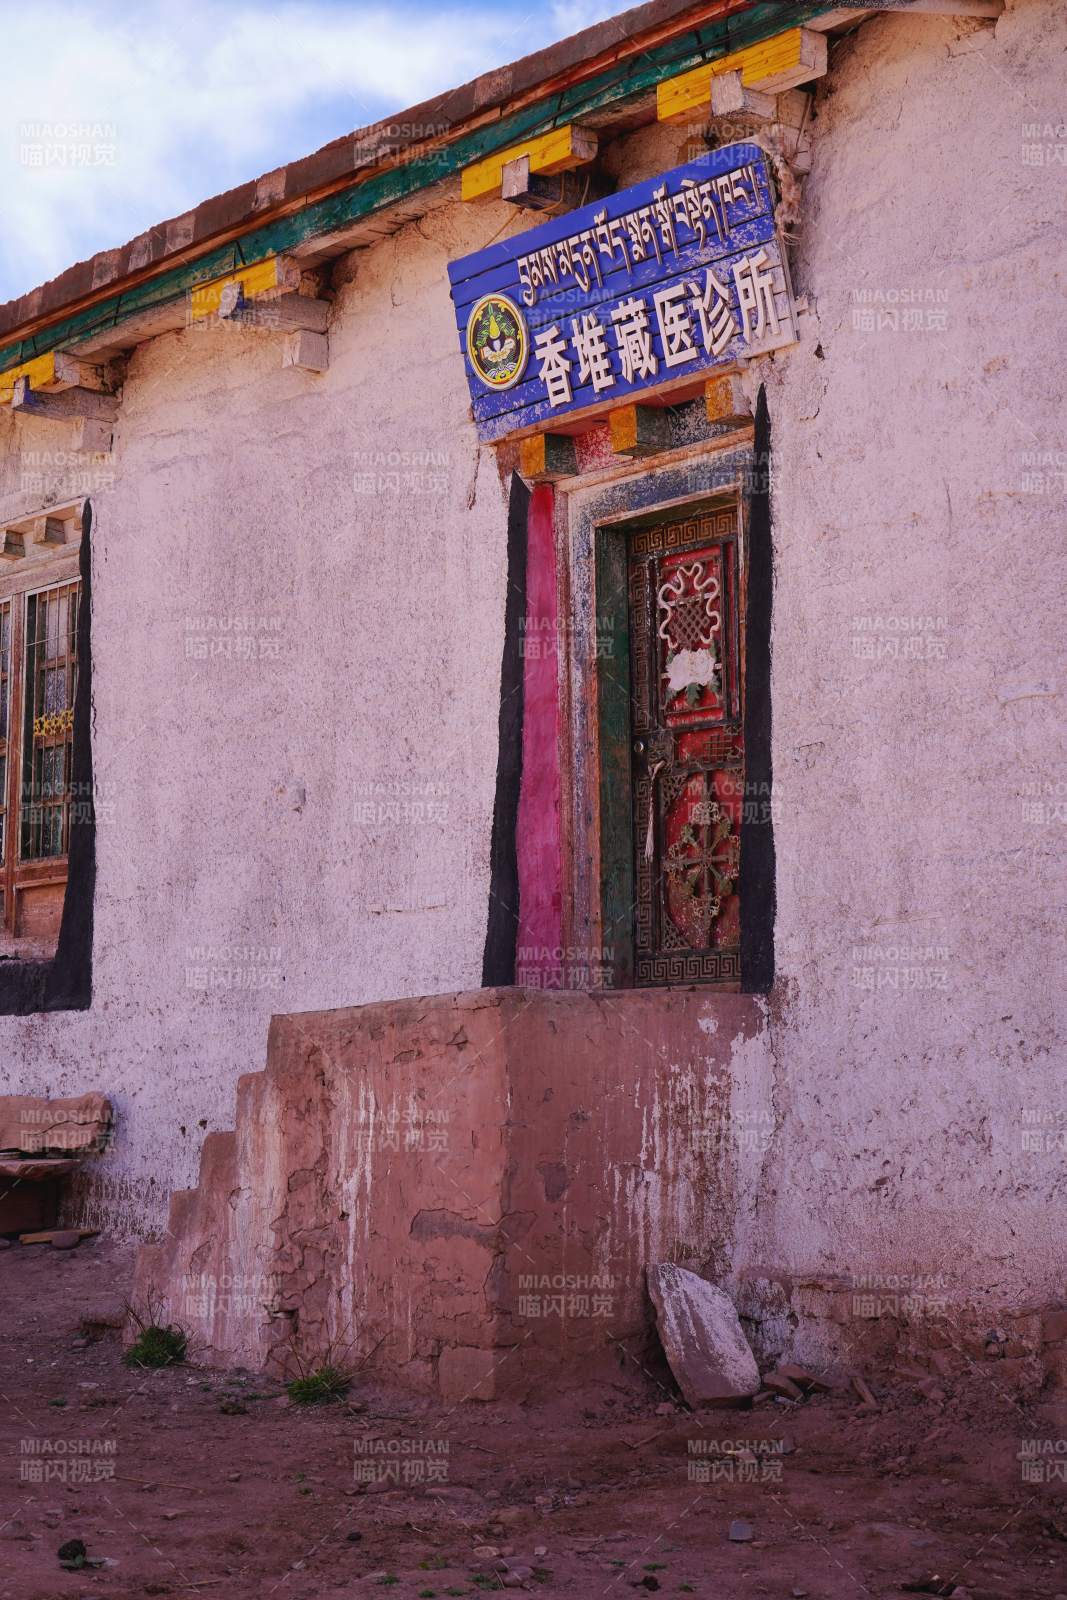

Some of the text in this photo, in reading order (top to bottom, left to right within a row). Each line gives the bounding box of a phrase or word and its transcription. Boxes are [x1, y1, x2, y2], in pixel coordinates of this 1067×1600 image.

[535, 248, 780, 407] 香堆藏医诊所
